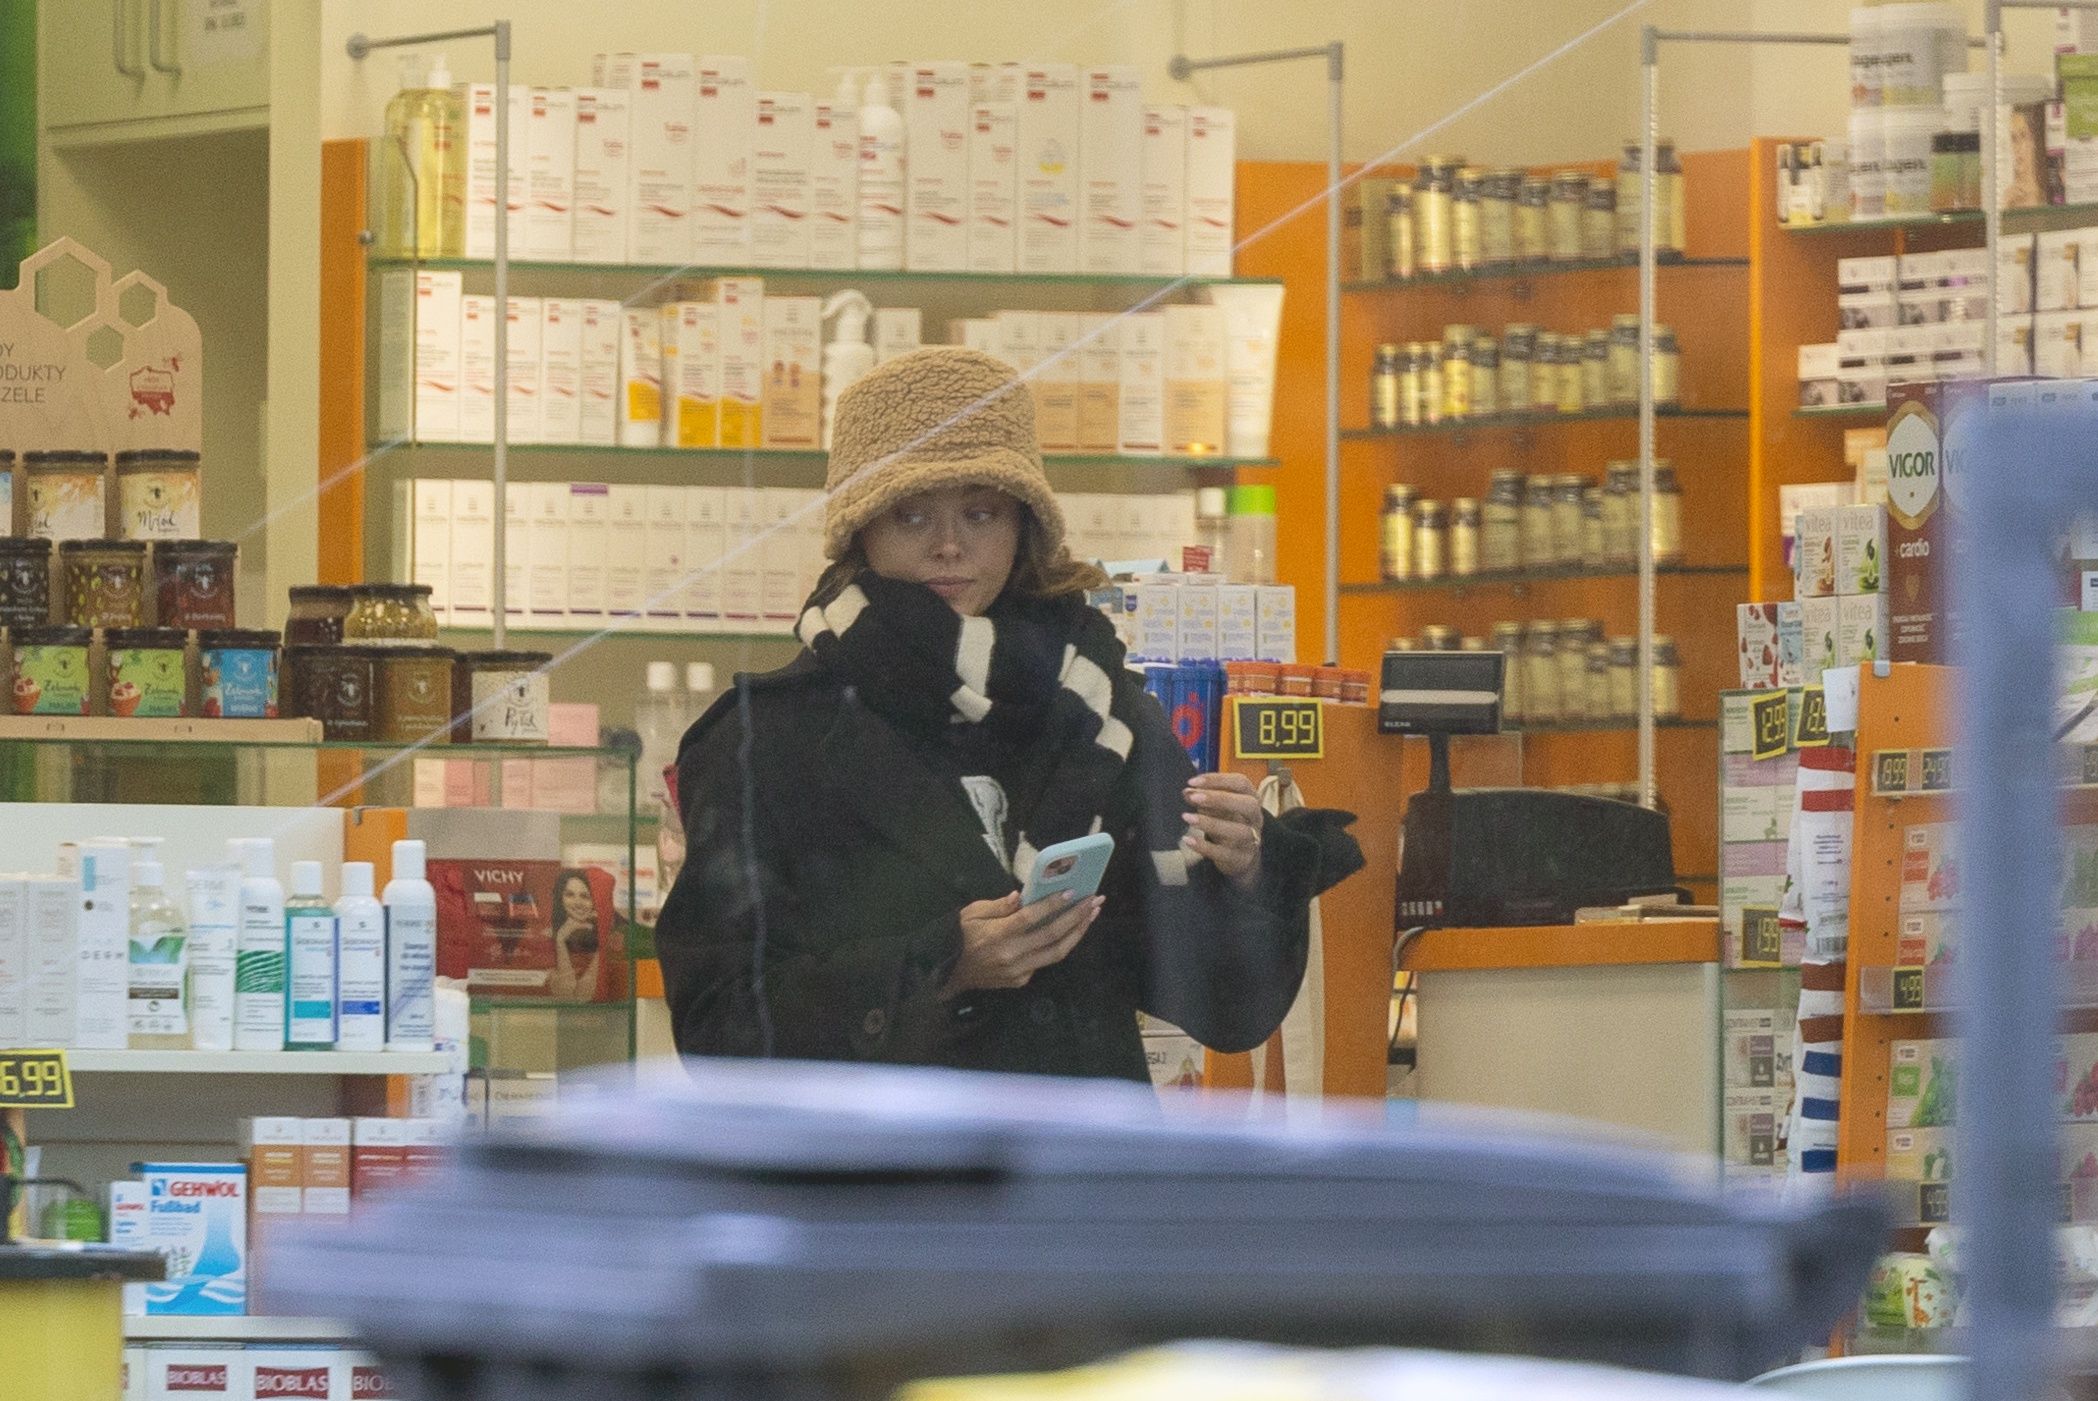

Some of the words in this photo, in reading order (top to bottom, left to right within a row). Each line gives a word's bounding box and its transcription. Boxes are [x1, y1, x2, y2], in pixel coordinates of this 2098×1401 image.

[1888, 450, 1935, 478] VIGOR
[475, 870, 525, 884] VICHY
[168, 1371, 226, 1385] BIOBLAS
[256, 1376, 329, 1392] BIOBLAS
